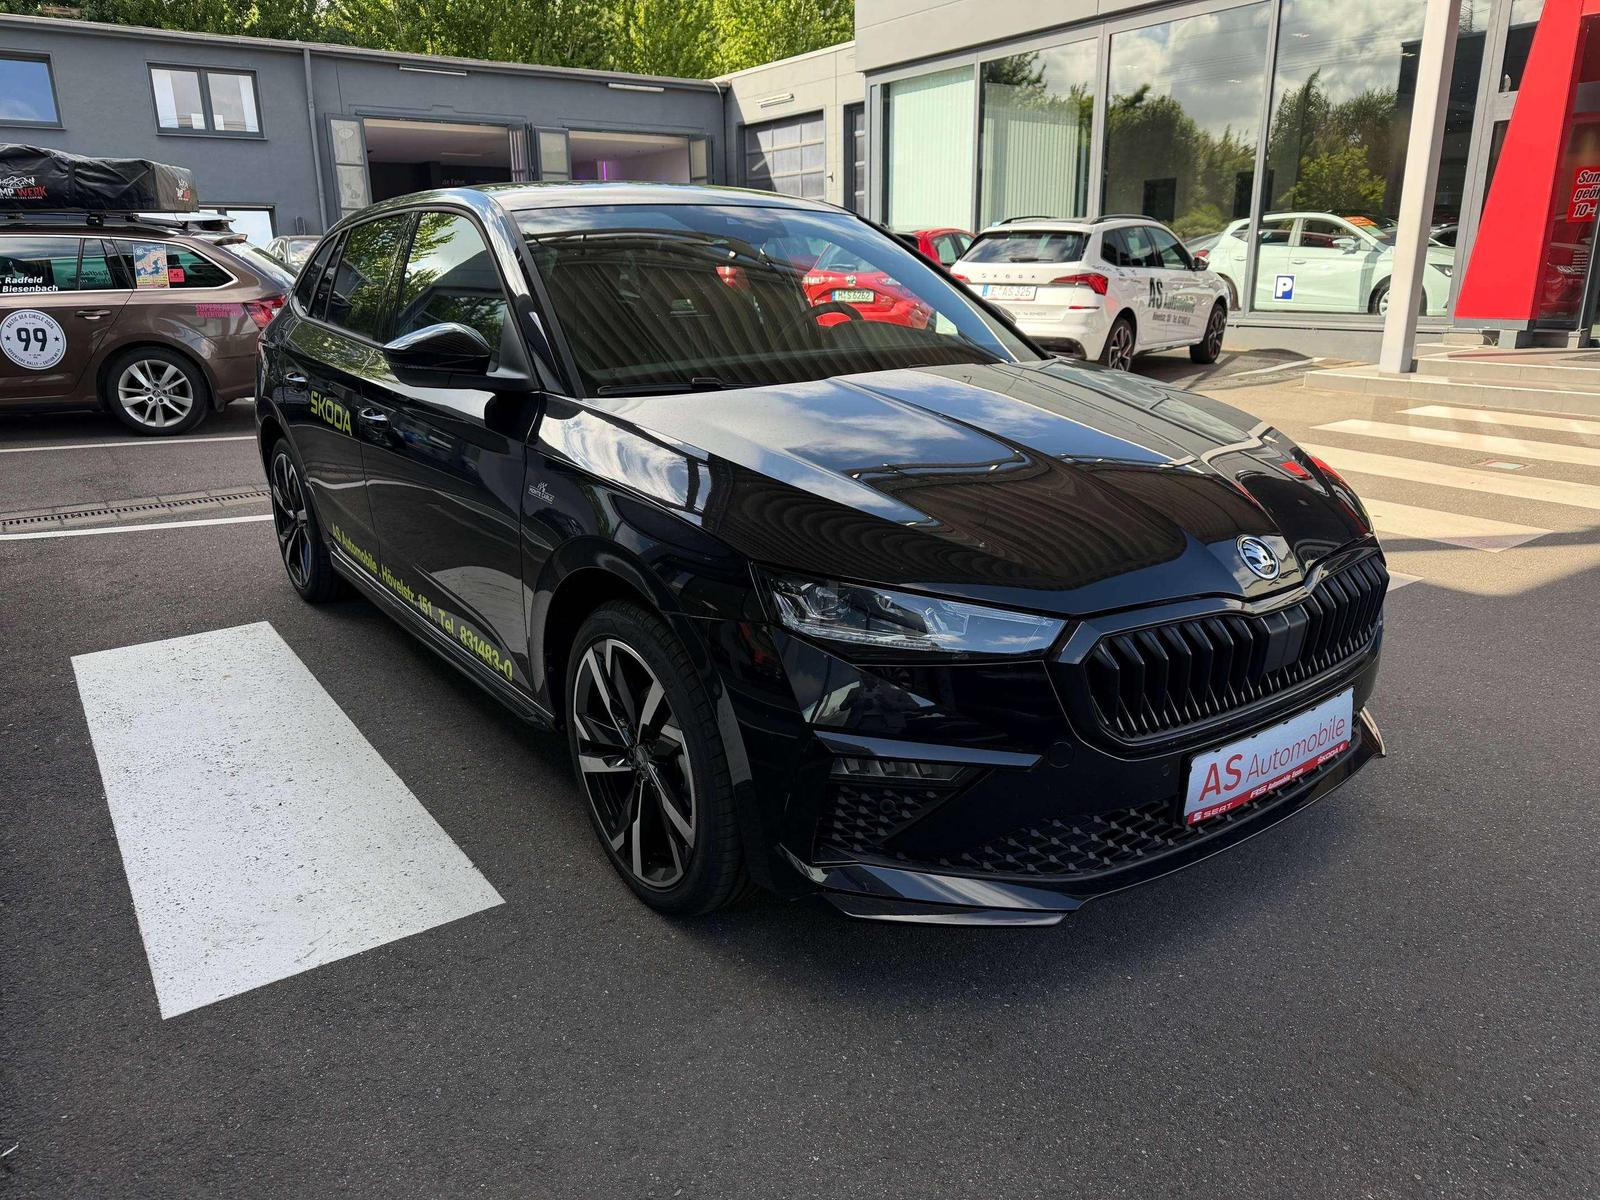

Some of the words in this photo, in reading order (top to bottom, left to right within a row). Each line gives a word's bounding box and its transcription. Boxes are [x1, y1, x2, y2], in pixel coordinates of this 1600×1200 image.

[16, 186, 48, 198] WERK
[2, 285, 59, 293] Biesenbach
[5, 276, 43, 284] Radfeld
[1275, 277, 1293, 298] P
[1148, 277, 1163, 309] AS
[16, 327, 47, 352] 99
[341, 530, 378, 575] Automobile
[418, 594, 433, 618] 151
[460, 625, 513, 681] 831483-0
[1199, 753, 1243, 802] AS
[1245, 714, 1346, 784] Automobile
[1203, 802, 1233, 819] SEAT
